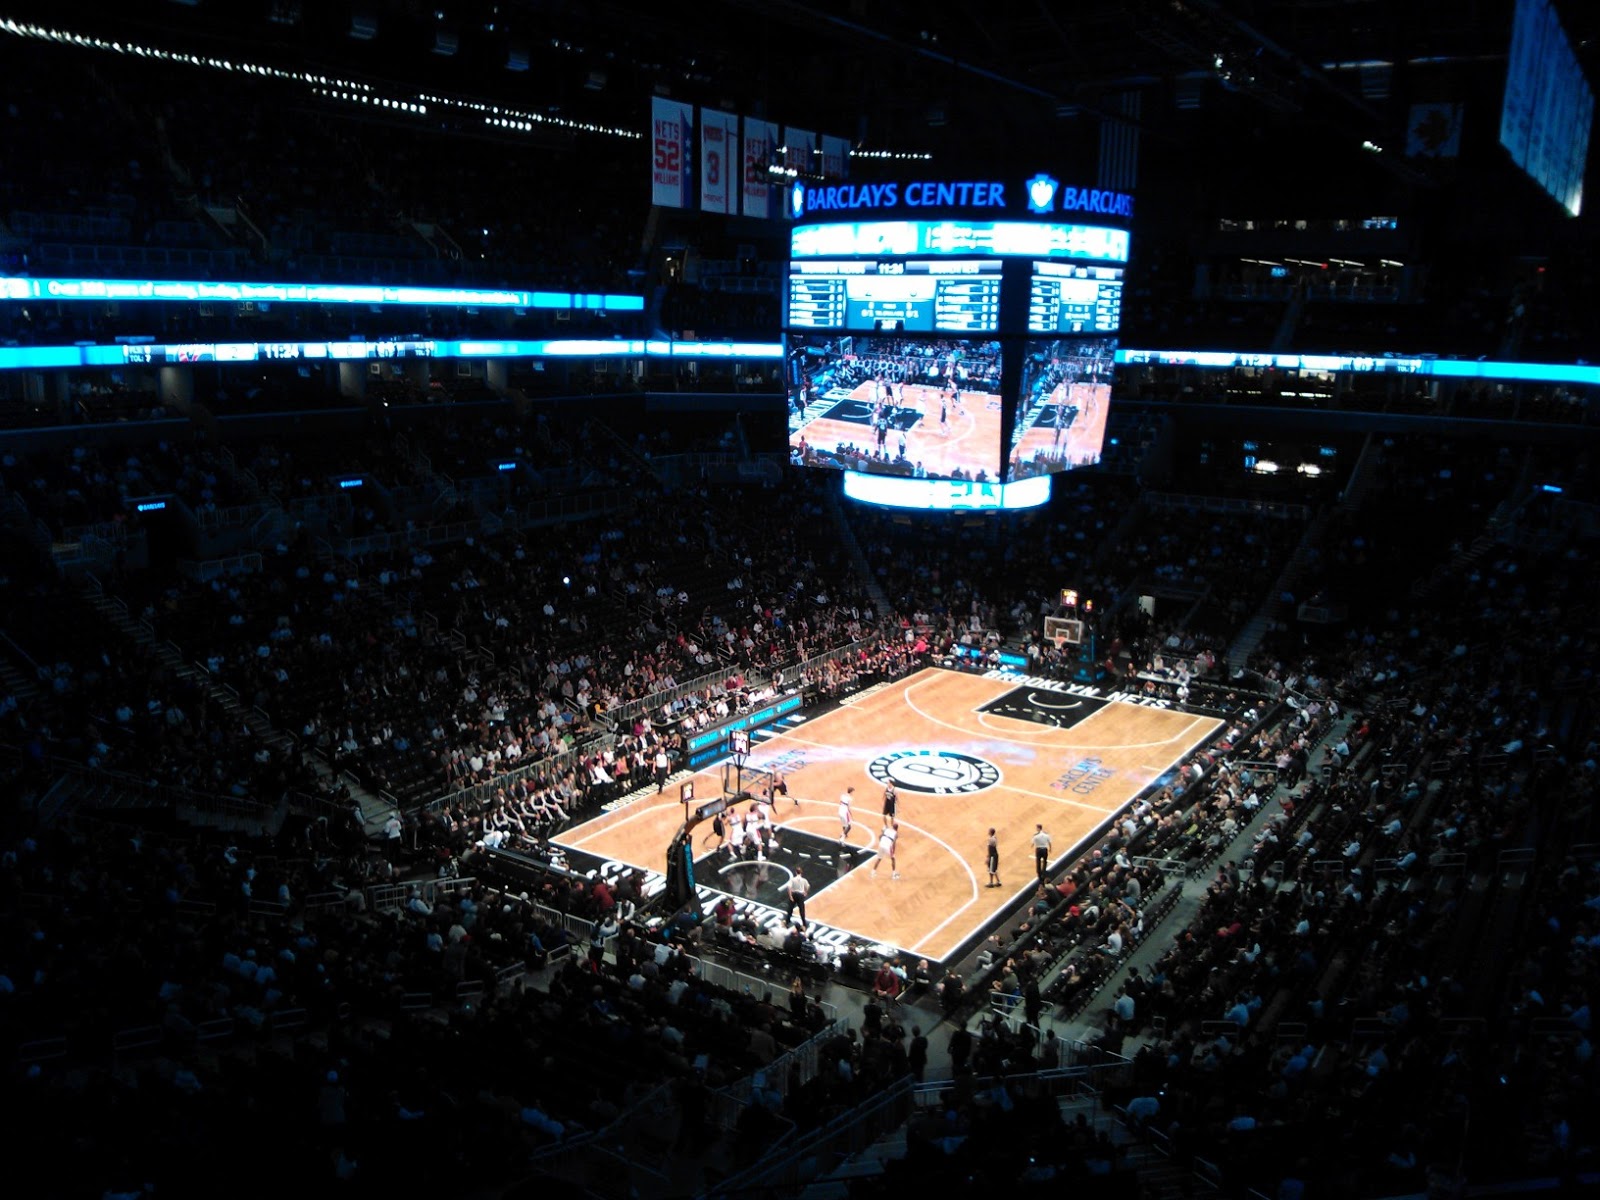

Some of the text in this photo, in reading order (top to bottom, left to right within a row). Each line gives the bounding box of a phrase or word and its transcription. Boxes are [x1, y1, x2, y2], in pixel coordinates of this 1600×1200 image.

[655, 119, 679, 140] NETS
[655, 138, 679, 171] 52
[707, 150, 719, 185] 3
[807, 182, 1006, 210] BARCLAYS CENTER
[264, 344, 299, 359] 11:24
[981, 669, 1171, 709] BROOKLYN NETS
